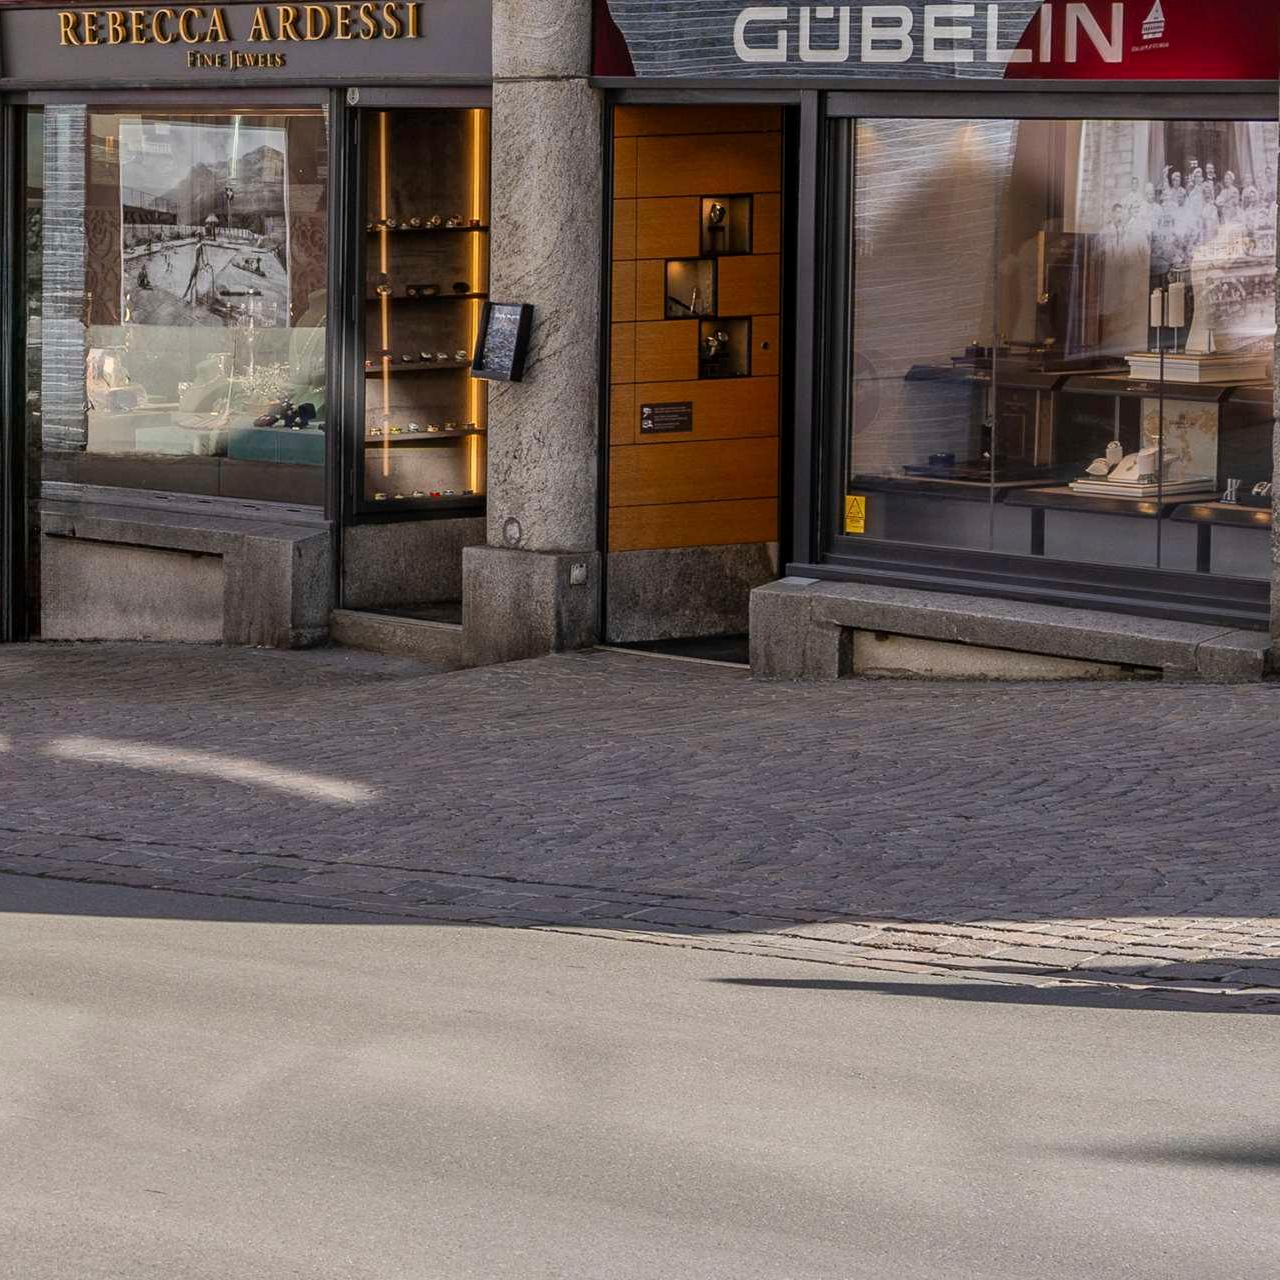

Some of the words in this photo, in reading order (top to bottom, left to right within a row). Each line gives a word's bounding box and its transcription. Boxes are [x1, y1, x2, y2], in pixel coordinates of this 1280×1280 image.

[56, 6, 231, 47] REBECCA
[247, 1, 420, 43] ARDESSI
[732, 2, 1124, 63] GÜBELIN
